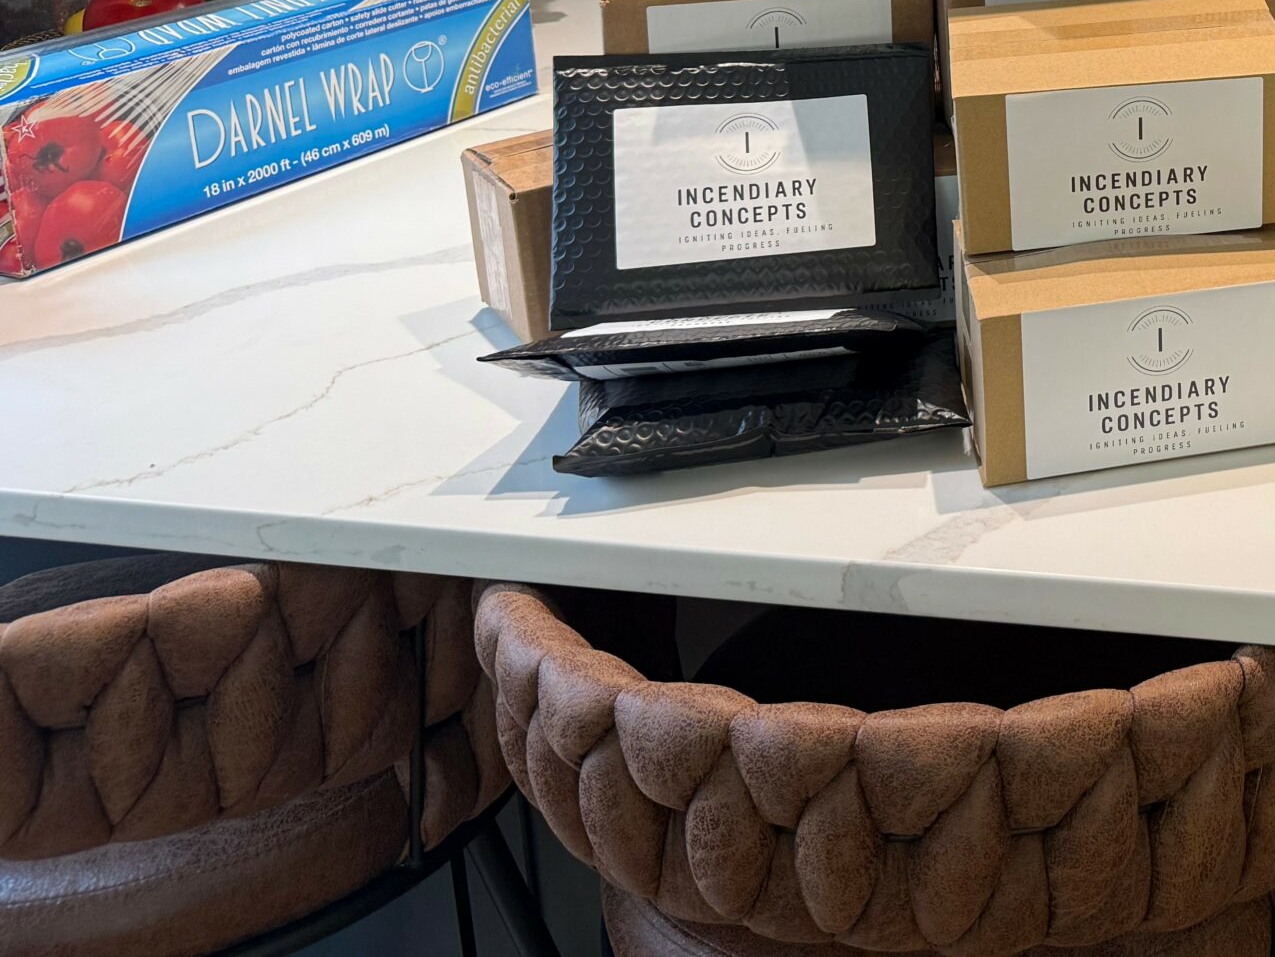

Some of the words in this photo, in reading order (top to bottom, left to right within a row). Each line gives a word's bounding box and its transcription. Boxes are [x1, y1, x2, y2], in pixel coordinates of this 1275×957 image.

[281, 25, 321, 42] polycoated
[322, 18, 344, 30] carton
[227, 58, 271, 76] embalagem
[272, 47, 305, 62] revestida
[336, 36, 346, 45] de
[187, 78, 317, 170] DARNEL
[319, 52, 395, 122] WRAP
[203, 182, 221, 199] 18
[222, 176, 235, 193] in
[236, 177, 246, 187] x
[247, 162, 278, 183] 2000
[279, 158, 291, 172] ft
[300, 149, 320, 167] (46
[321, 143, 341, 157] cm
[342, 140, 351, 150] x
[351, 131, 373, 146] 609
[373, 123, 390, 141] m)
[677, 178, 818, 206] INCENDIARY
[1071, 165, 1208, 193] INCENDIARY
[690, 202, 807, 228] CONCEPTS
[1083, 188, 1197, 214] CONCEPTS
[1088, 375, 1230, 412] INCENDIARY
[1101, 401, 1219, 434] CONCEPTS
